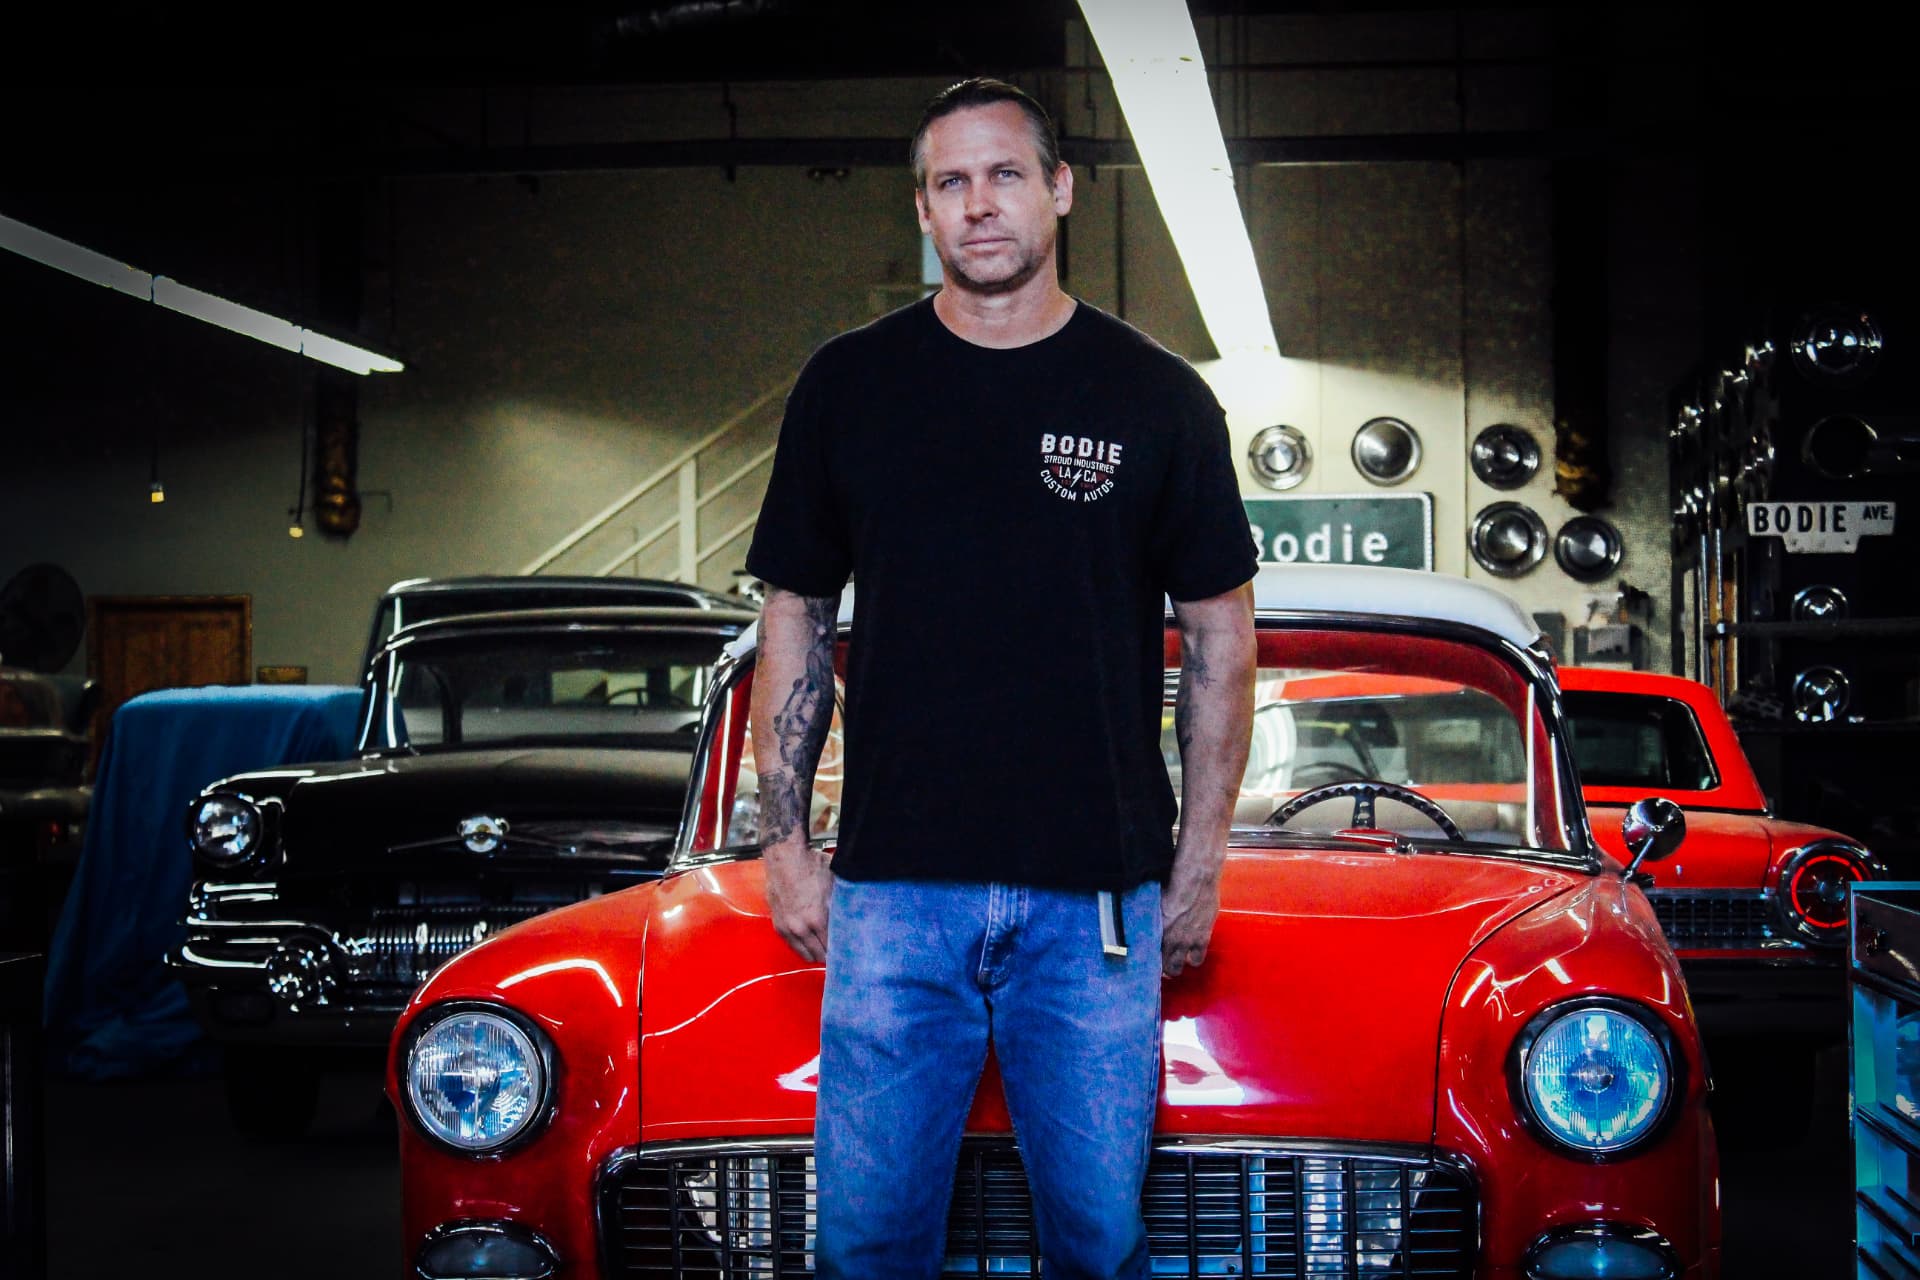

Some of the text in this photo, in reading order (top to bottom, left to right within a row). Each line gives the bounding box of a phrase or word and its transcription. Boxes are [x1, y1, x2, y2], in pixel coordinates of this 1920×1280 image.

[1040, 432, 1123, 465] BODIE
[1043, 454, 1115, 475] STROUD INDUSTRIES
[1058, 465, 1072, 479] LA
[1083, 469, 1097, 484] CA
[1040, 468, 1115, 503] CUSTOM AUTOS
[1754, 505, 1893, 533] BODIE AVE.
